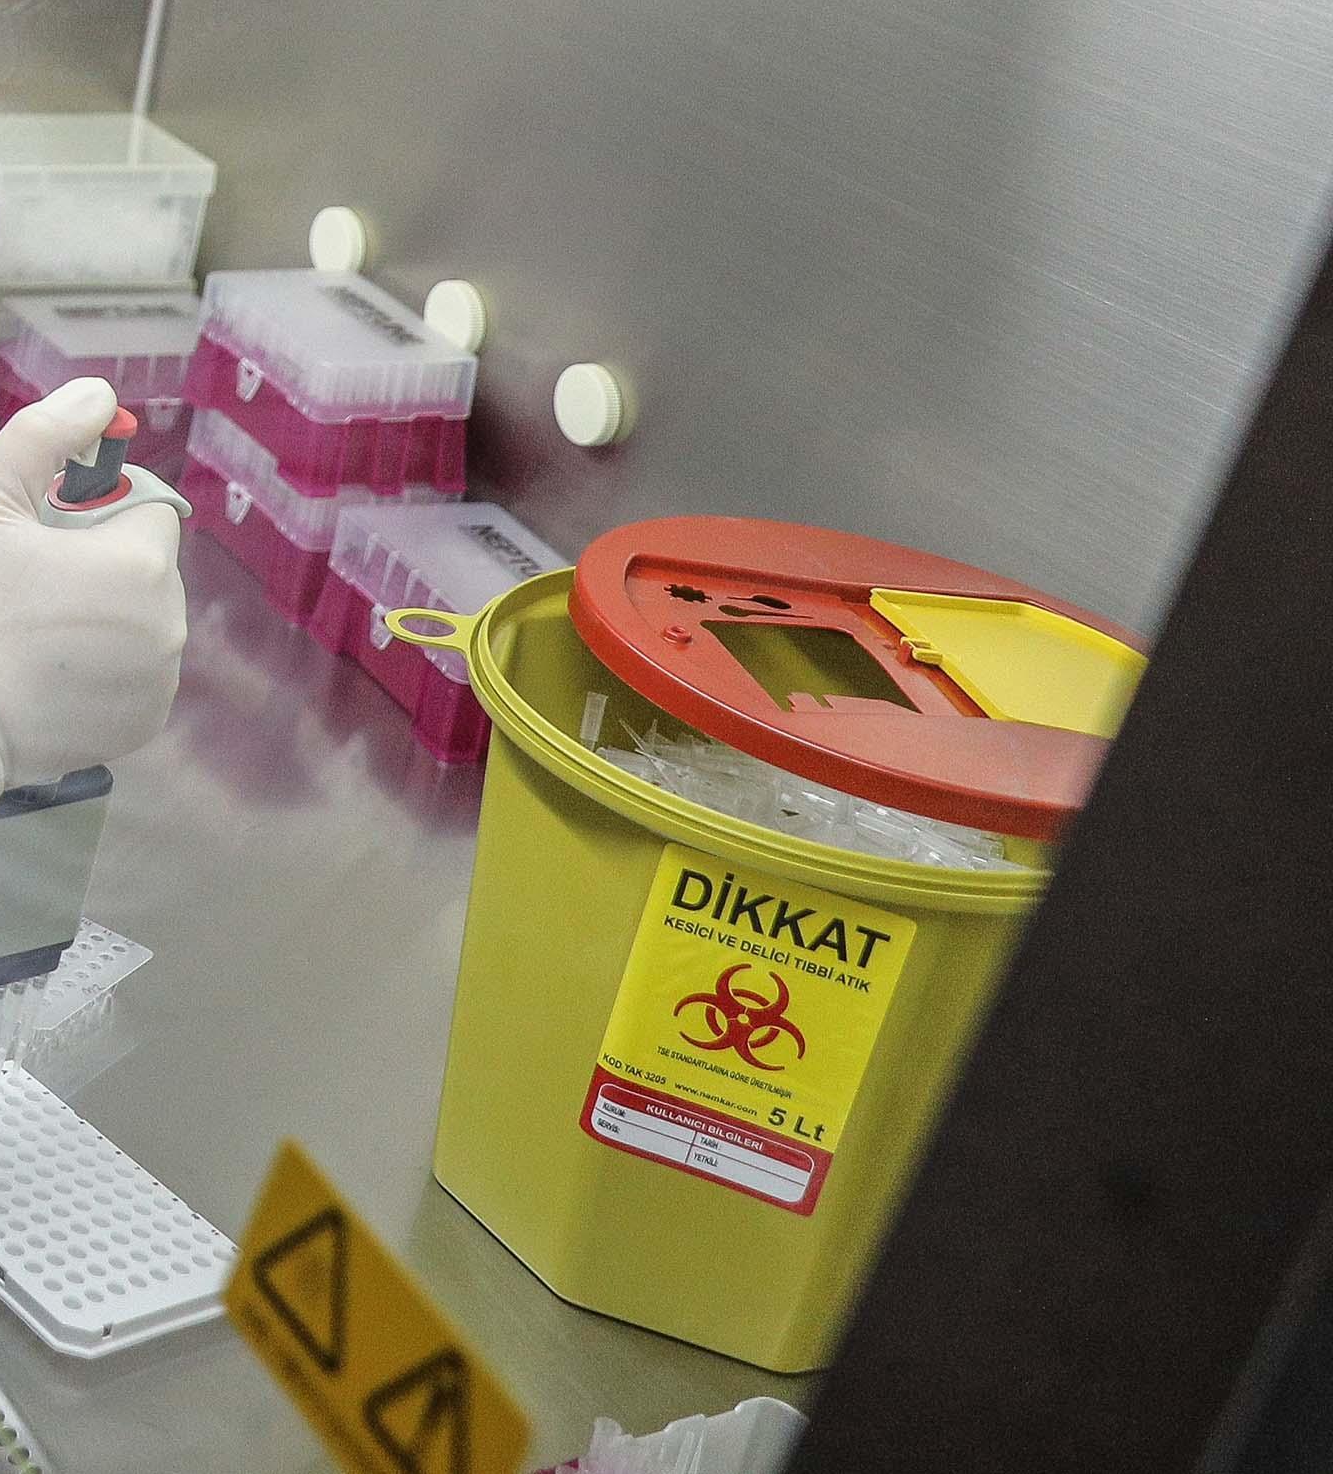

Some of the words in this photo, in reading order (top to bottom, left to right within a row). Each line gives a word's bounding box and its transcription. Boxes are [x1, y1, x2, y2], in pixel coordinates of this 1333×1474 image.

[670, 867, 891, 969] DİKKAT
[664, 915, 715, 940] KESİCİ
[717, 931, 738, 948] VE
[740, 940, 790, 965] DELİCİ
[794, 957, 836, 980] TIBBİ
[835, 973, 872, 994] ATIK
[603, 1053, 623, 1069] KOD
[624, 1064, 643, 1079] TAK
[644, 1071, 667, 1085] 3205
[657, 1046, 671, 1057] TSE
[729, 1070, 750, 1085] GÖRE
[674, 1082, 758, 1117] www.namkar.com
[645, 1103, 706, 1132] KULLANICI
[707, 1121, 765, 1151] BİLGİLERİ
[767, 1105, 787, 1127] 5
[793, 1116, 826, 1143] Lt
